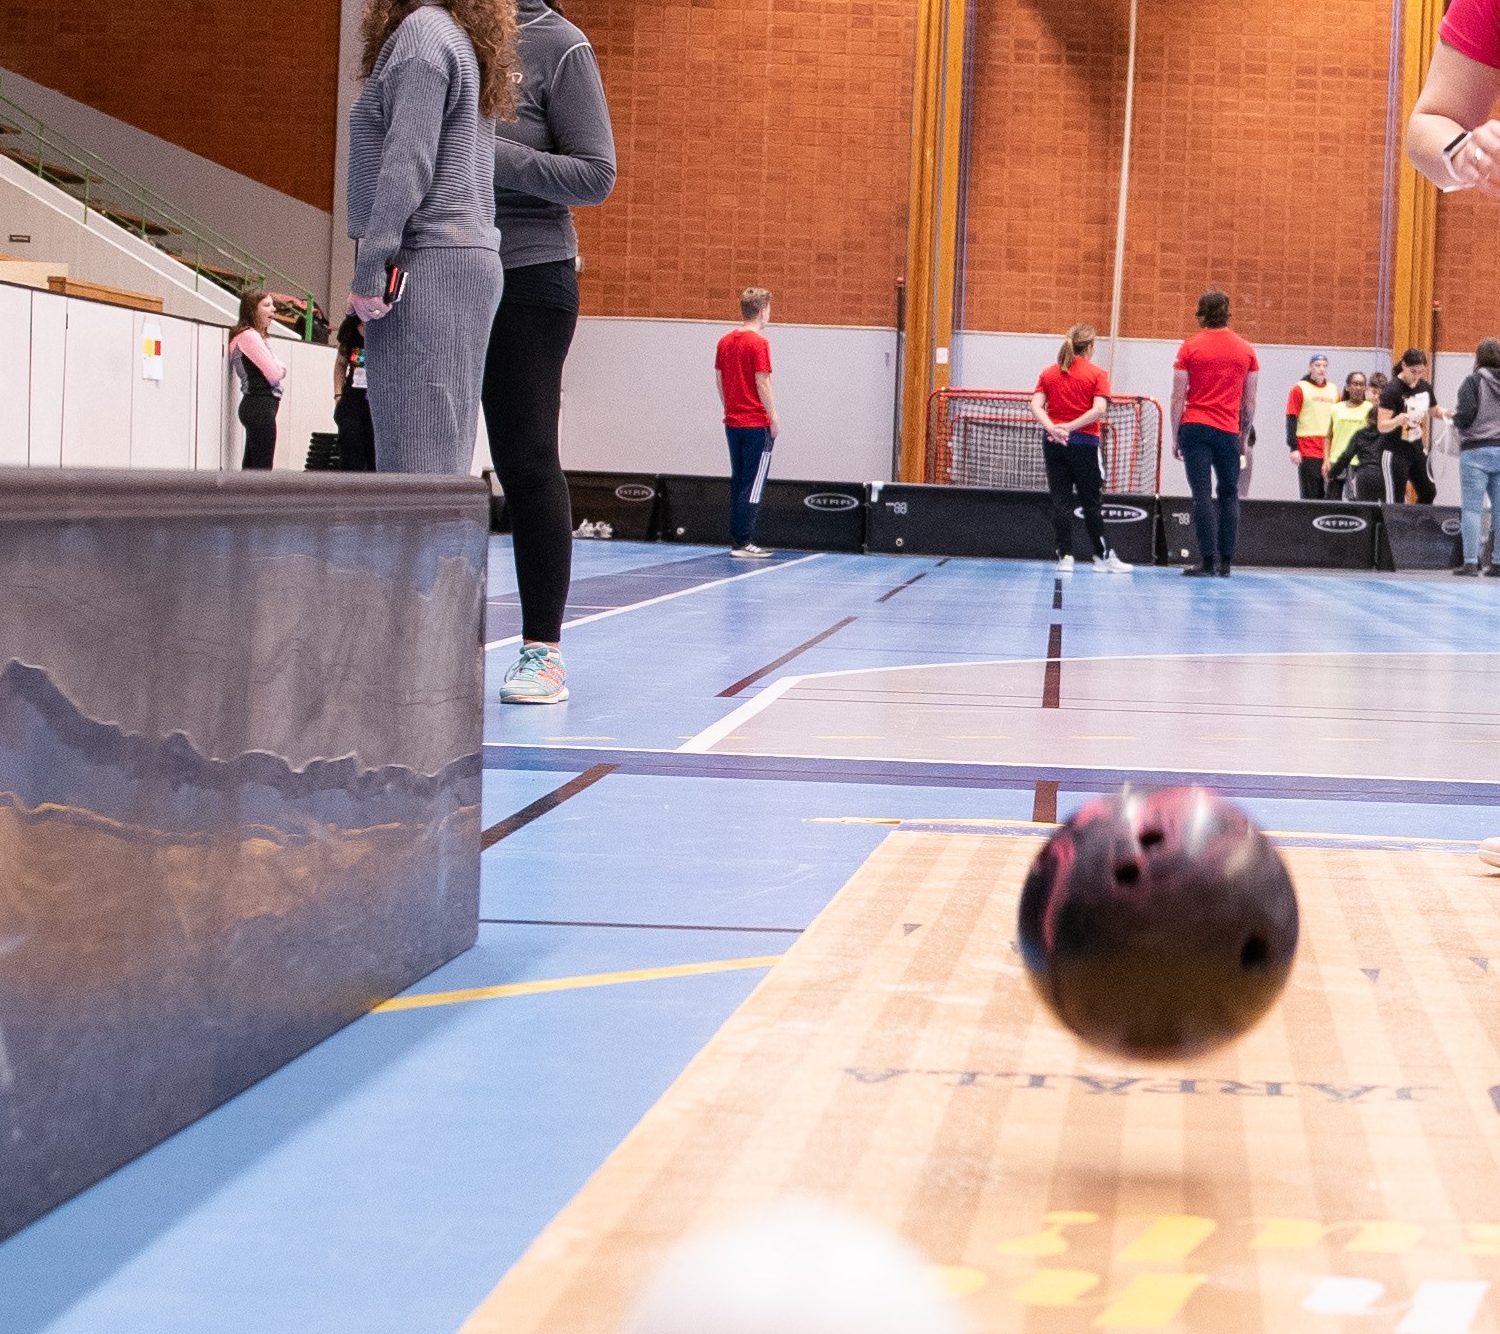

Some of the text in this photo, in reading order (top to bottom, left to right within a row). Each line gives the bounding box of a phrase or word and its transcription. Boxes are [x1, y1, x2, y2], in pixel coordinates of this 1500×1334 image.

[829, 498, 852, 506] PIPE
[1108, 509, 1139, 518] PIPE
[1318, 519, 1360, 528] FAT PIPE
[838, 1066, 1442, 1105] JÄRFÄLLA
